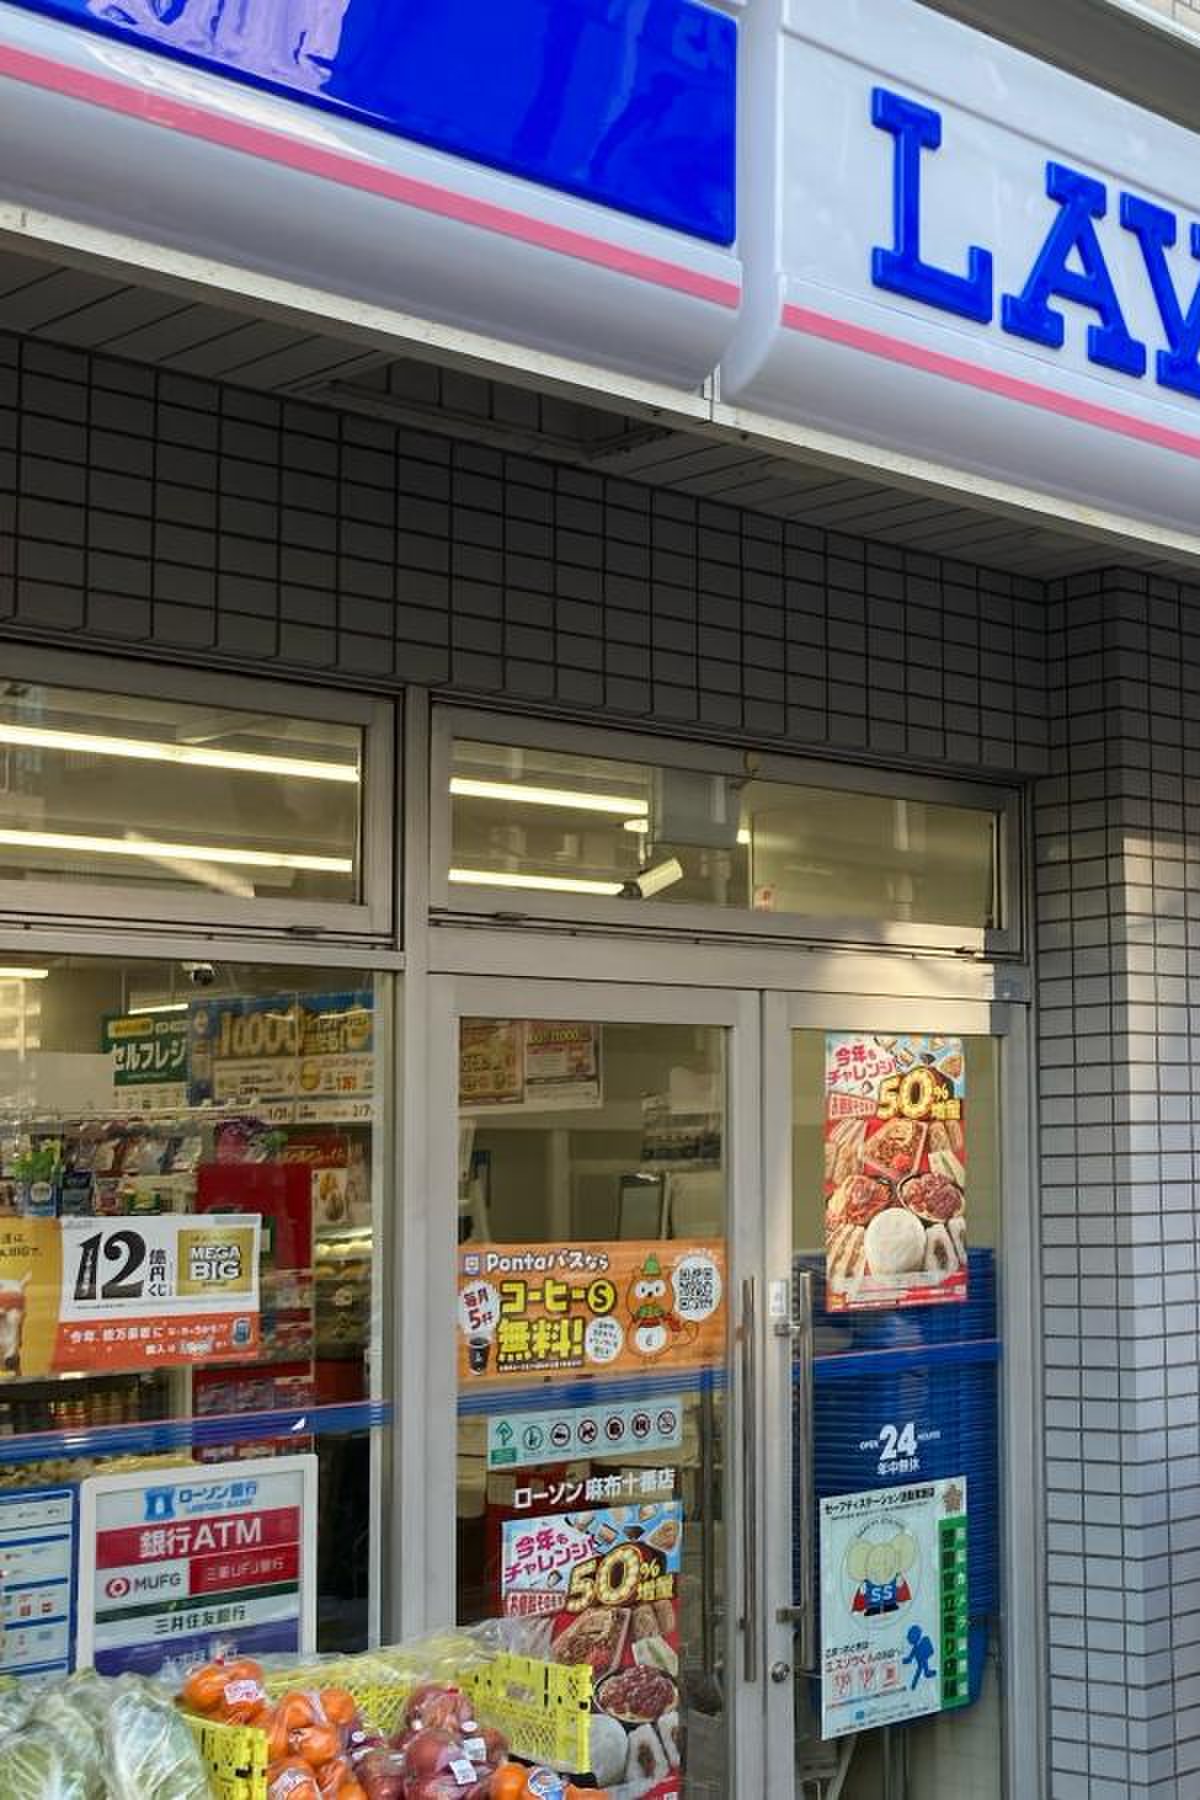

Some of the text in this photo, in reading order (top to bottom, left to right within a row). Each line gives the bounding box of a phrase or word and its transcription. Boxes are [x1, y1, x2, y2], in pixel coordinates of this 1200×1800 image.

[111, 1038, 187, 1072] セルフレジ
[74, 1230, 147, 1301] 12
[191, 1246, 241, 1261] MEGA
[190, 1261, 243, 1281] BIG
[879, 1423, 918, 1461] 24
[178, 1481, 257, 1503] ローソン銀行
[139, 1518, 262, 1559] 銀行ATM
[515, 1528, 569, 1561] 今年も
[134, 1572, 182, 1592] MUFG
[870, 1583, 894, 1603] SS
[155, 1605, 247, 1634] 三井住友銀行
